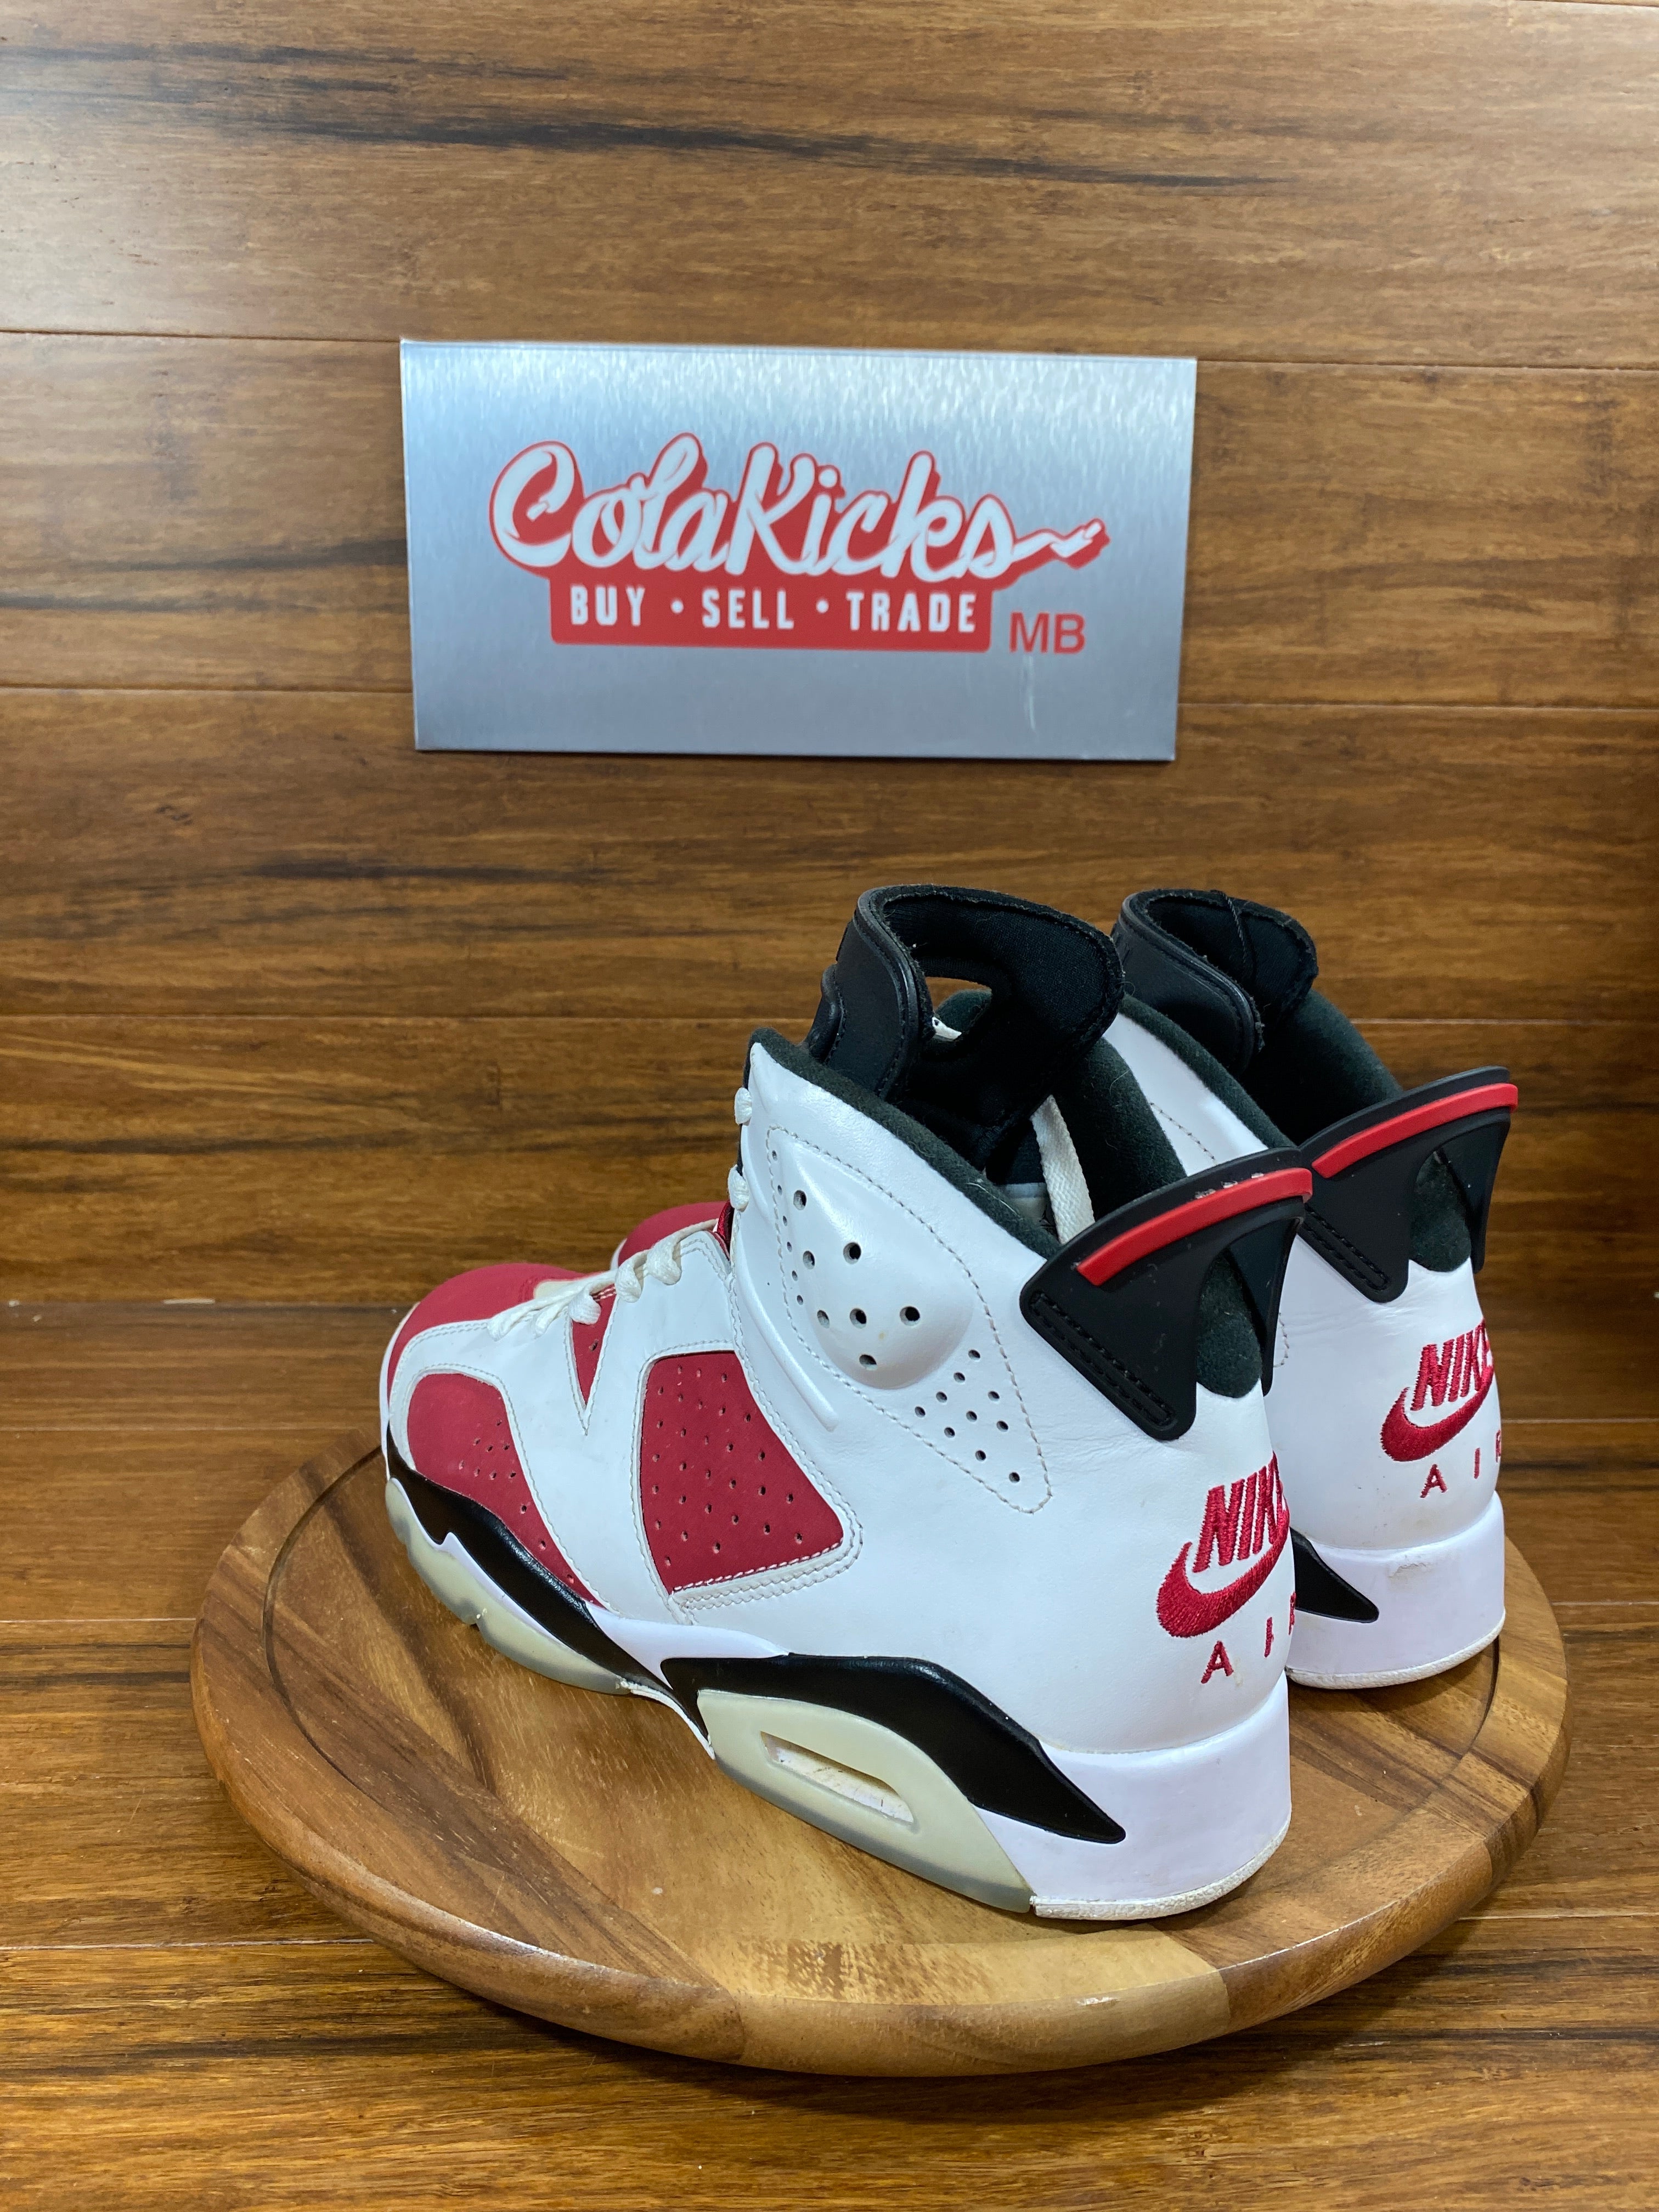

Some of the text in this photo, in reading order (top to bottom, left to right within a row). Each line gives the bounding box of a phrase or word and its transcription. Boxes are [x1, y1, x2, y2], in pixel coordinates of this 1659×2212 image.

[492, 433, 1107, 583] ColaKicks
[570, 586, 977, 633] BUY SELL TRADE
[1009, 611, 1086, 653] MB
